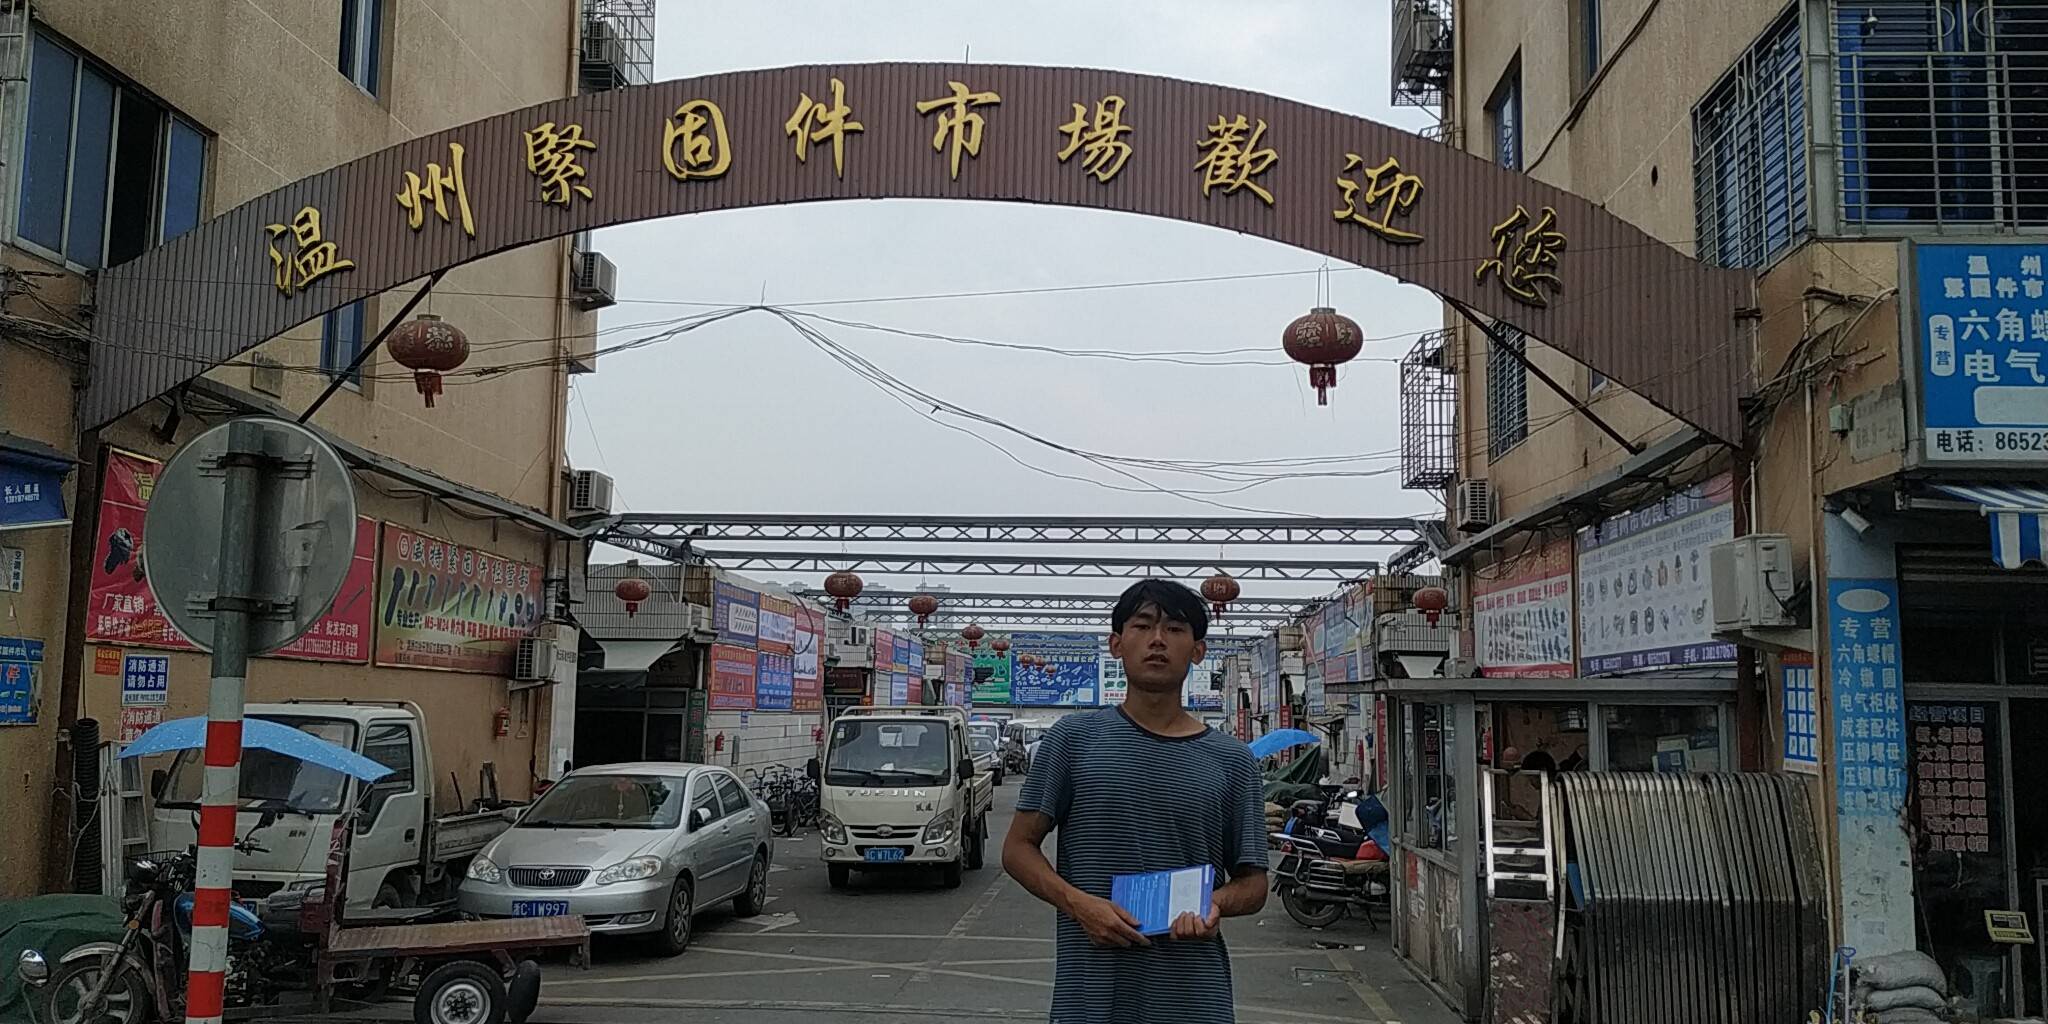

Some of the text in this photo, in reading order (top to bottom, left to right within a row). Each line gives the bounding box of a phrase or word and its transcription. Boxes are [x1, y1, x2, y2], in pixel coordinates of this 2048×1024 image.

[1934, 325, 1952, 366] 专营
[1964, 349, 2046, 384] 电气
[1838, 616, 1893, 640] 专营
[128, 659, 167, 673] 消防通道
[127, 674, 166, 689] 请勿占用
[1840, 692, 1899, 714] 电气柜体
[1841, 717, 1901, 739] 成套配件
